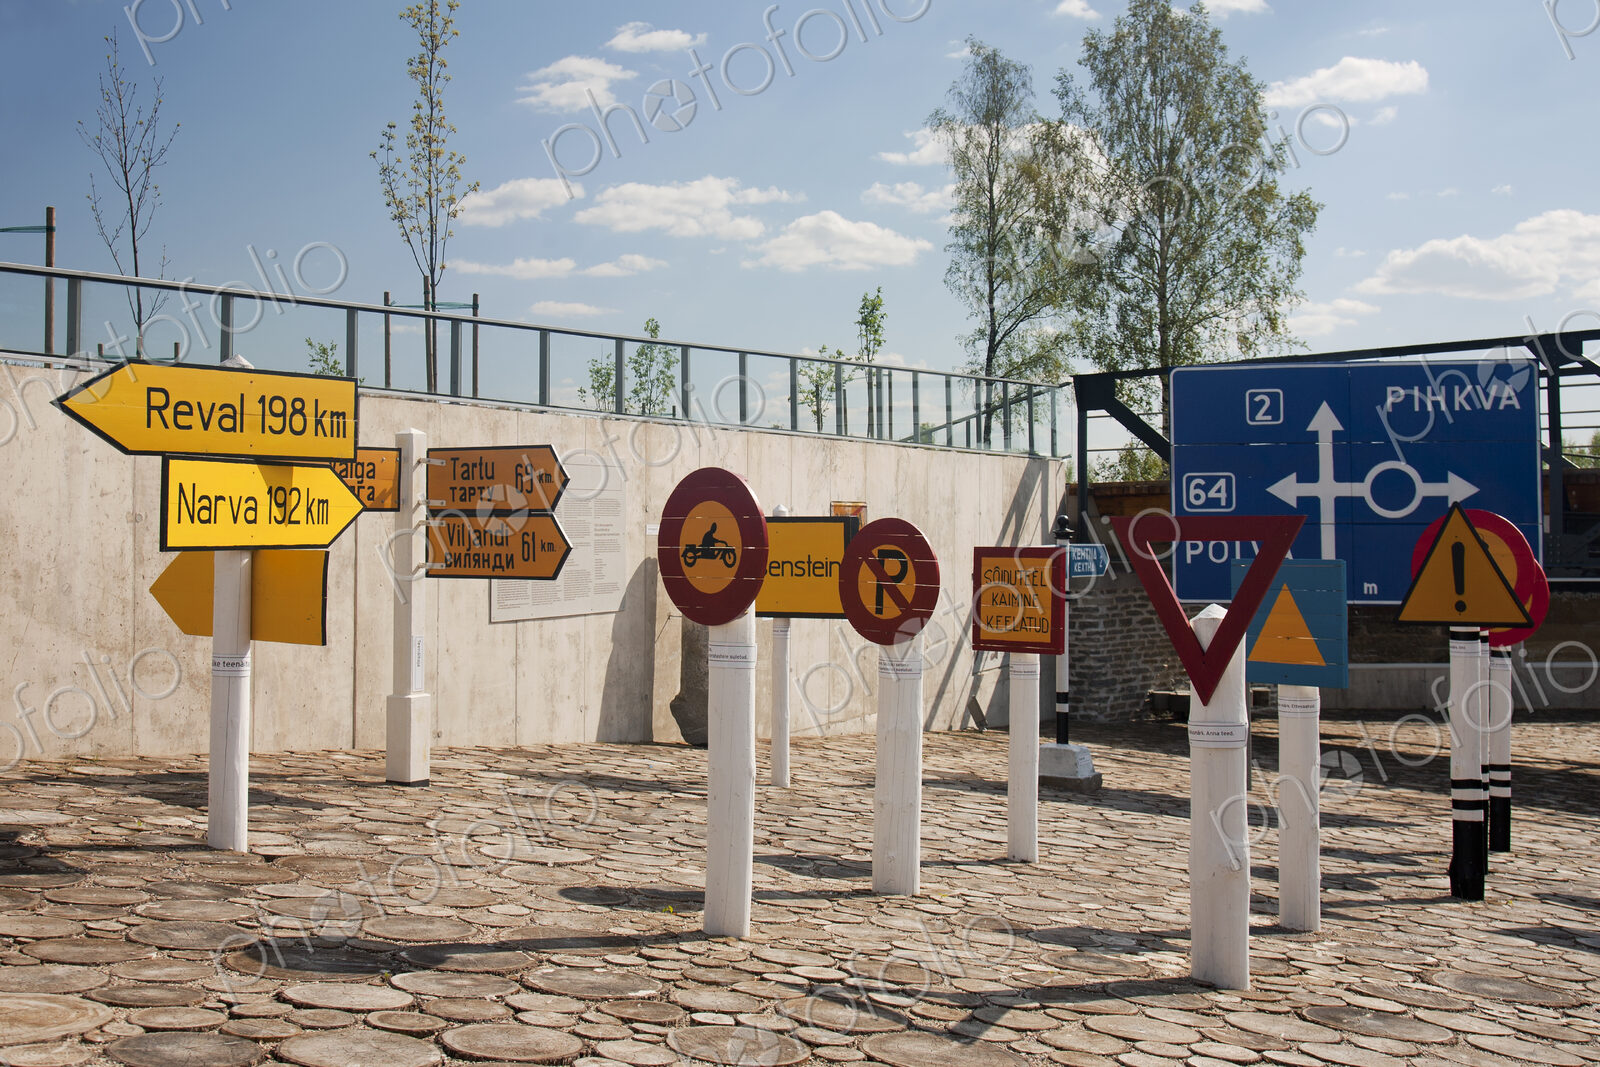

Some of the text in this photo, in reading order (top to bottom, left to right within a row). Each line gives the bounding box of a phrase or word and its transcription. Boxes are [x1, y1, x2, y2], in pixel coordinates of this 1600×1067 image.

[146, 387, 347, 439] Reval 198 km
[1255, 395, 1273, 421] 2
[1386, 385, 1521, 412] PIHKVA
[450, 457, 495, 481] Tartu
[515, 464, 534, 494] 69
[177, 483, 330, 525] Narva 192 km
[1189, 478, 1227, 507] 64
[447, 520, 509, 551] Viljandi
[521, 531, 536, 562] 61
[1363, 582, 1378, 594] m
[986, 615, 1049, 634] KEELATUD
